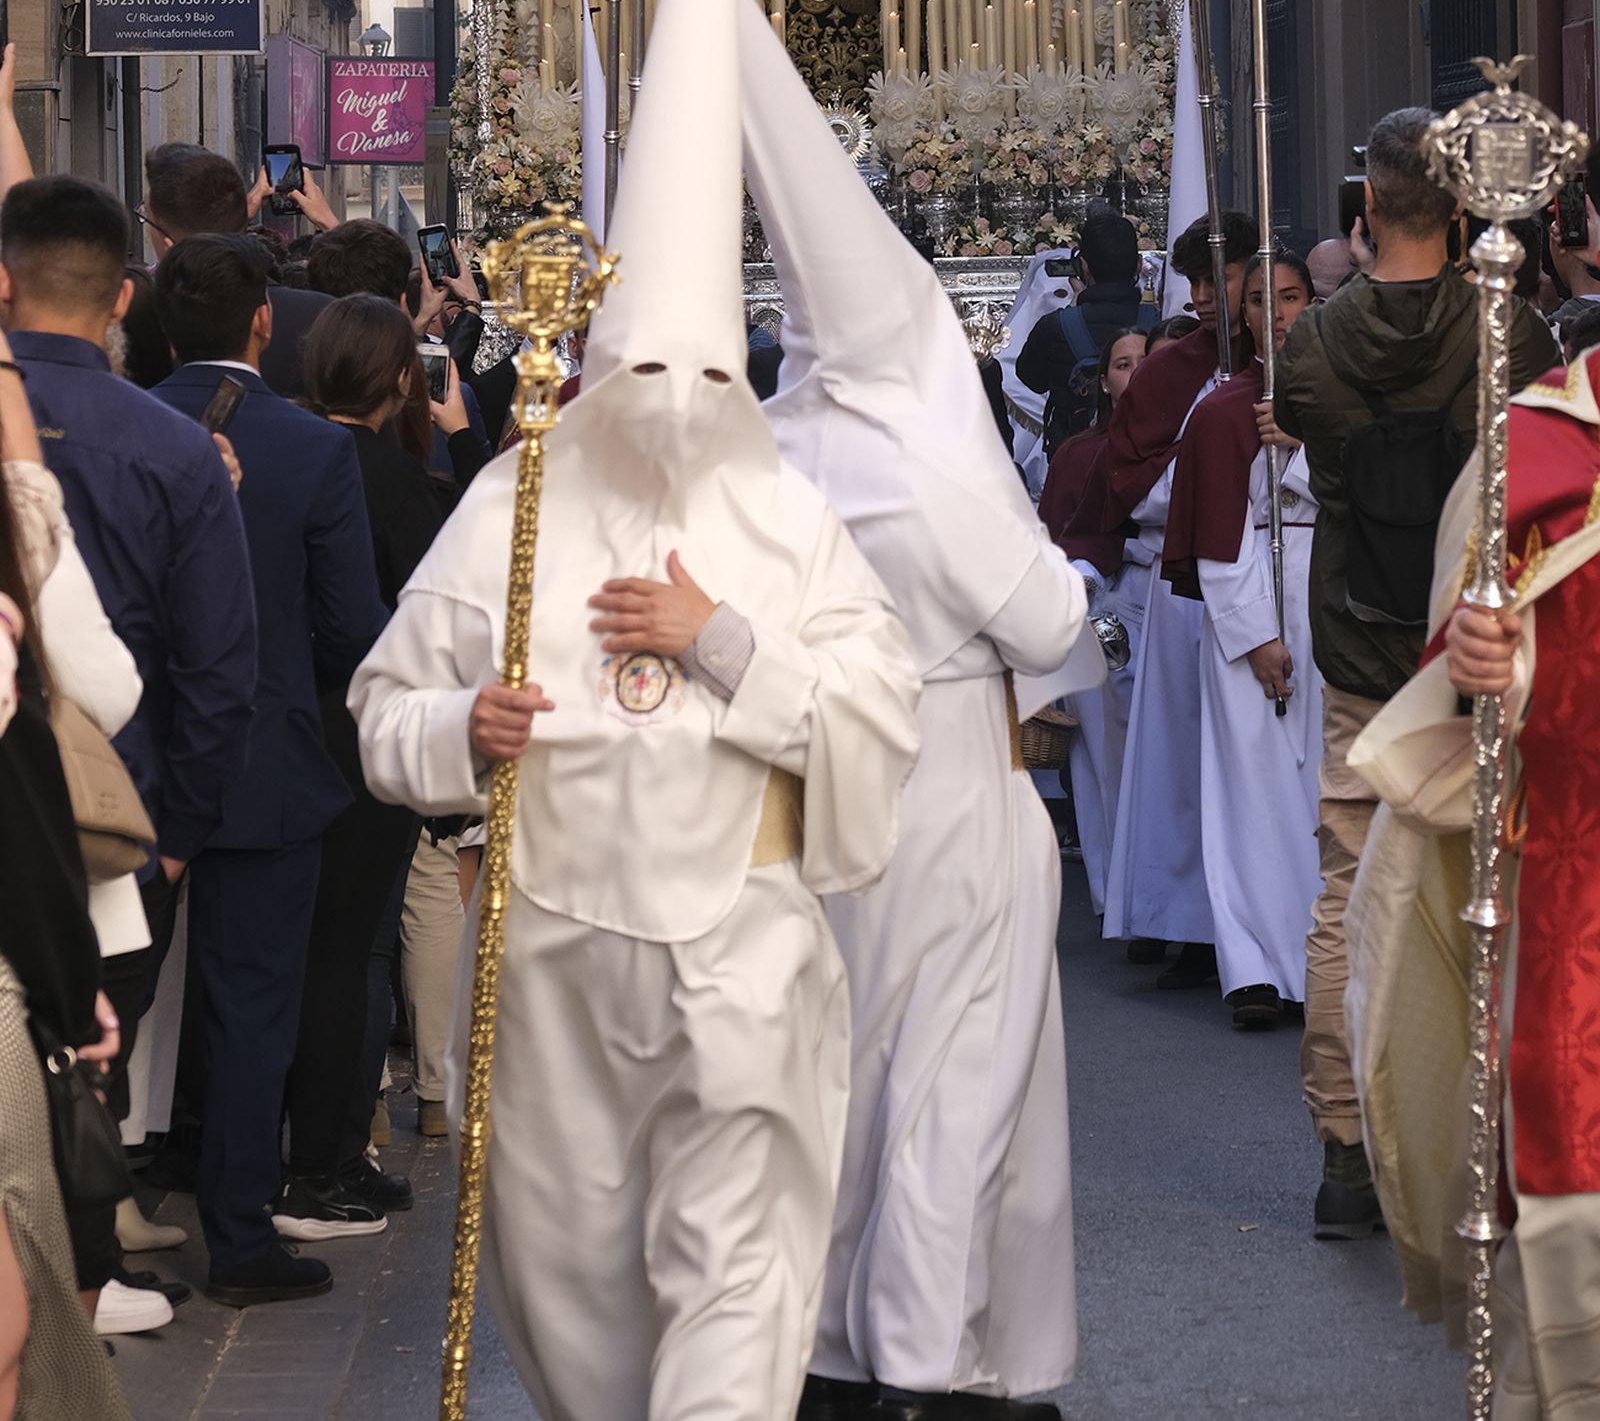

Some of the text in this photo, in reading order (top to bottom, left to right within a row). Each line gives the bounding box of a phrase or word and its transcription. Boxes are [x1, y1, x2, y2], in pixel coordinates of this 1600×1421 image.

[126, 12, 215, 24] C/ Ricardos, 9 Bajo
[115, 28, 235, 39] www.clinicafornieles.com
[335, 62, 430, 77] ZAPATERIA
[336, 80, 408, 118] Miguel
[371, 108, 389, 133] &
[336, 130, 414, 155] Vanesa
